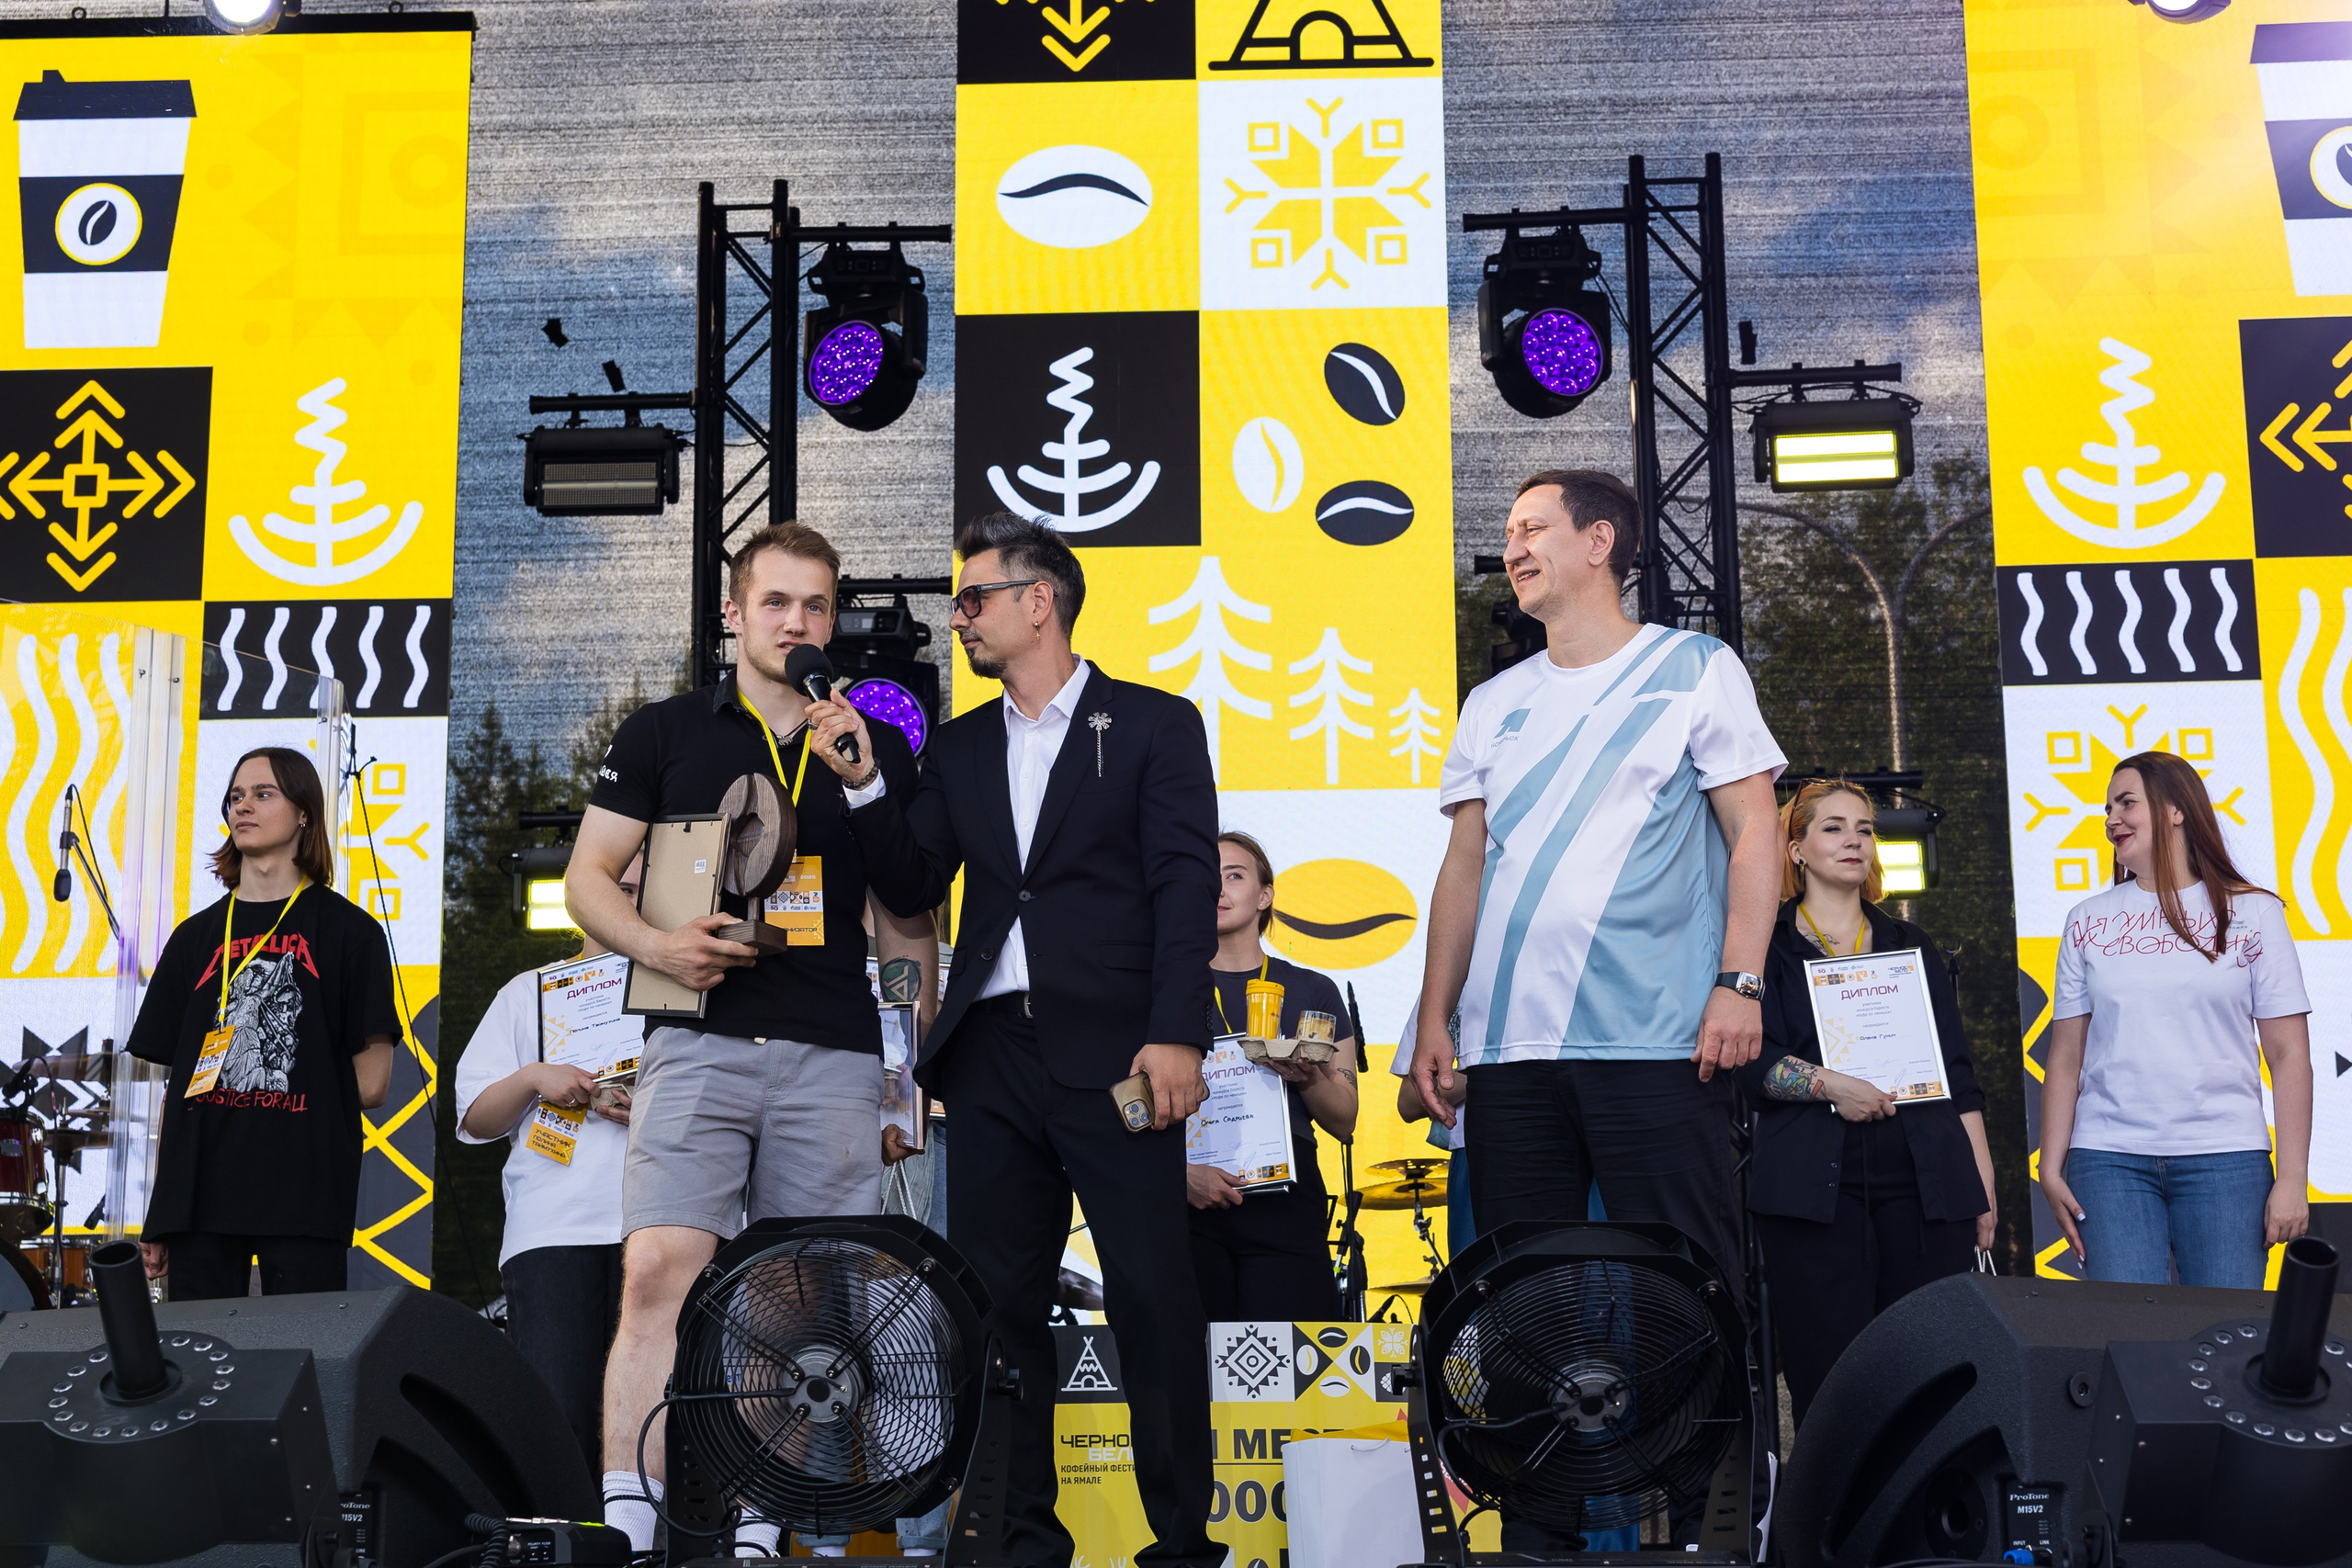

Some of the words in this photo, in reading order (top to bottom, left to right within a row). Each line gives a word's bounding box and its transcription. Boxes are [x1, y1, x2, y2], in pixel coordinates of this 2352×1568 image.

[194, 931, 320, 991] METALLICA
[567, 977, 622, 999] ДИПЛОМ
[1841, 985, 1898, 1000] ДИПЛОМ
[196, 1088, 251, 1108] JUSTICE
[254, 1090, 281, 1109] FOR
[282, 1094, 308, 1112] ALL
[533, 1134, 557, 1147] ПОЛИНА
[536, 1129, 571, 1147] УЧАСТНИК
[1061, 1434, 1130, 1448] ЧЕРНО
[1089, 1448, 1134, 1461] БЕЛ
[1061, 1463, 1108, 1472] КОФЕЙНЫЙ
[1074, 1476, 1102, 1484] ЯМАЛЕ
[2017, 1505, 2043, 1514] M15V2
